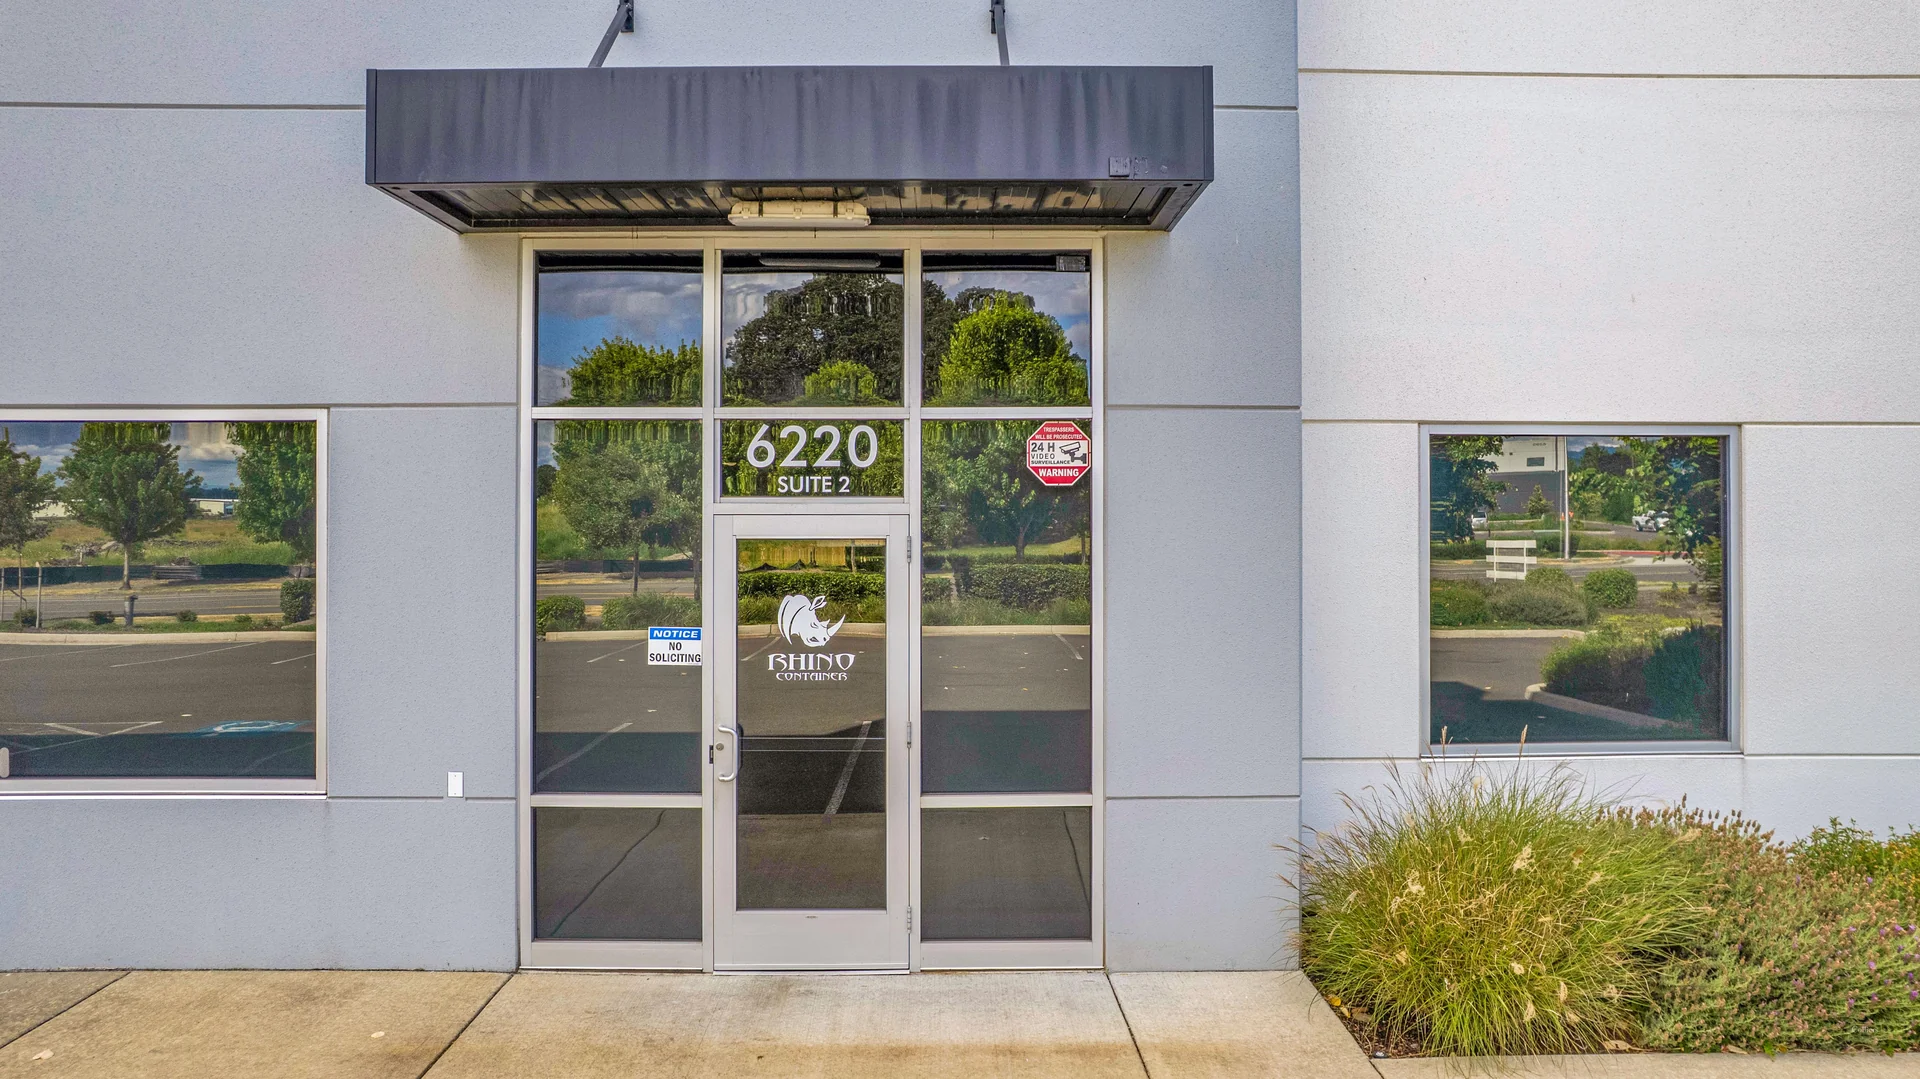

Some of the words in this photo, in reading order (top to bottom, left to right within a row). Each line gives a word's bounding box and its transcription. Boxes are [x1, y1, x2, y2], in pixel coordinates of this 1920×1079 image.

[747, 424, 878, 468] 6220
[1031, 442, 1044, 452] 24
[1048, 442, 1055, 452] H
[778, 476, 832, 493] SUITE
[838, 476, 850, 493] 2
[653, 630, 698, 638] NOTICE
[669, 641, 682, 651] NO
[649, 653, 701, 663] SOLICITING
[767, 653, 856, 671] RHINO
[776, 672, 848, 681] CONTAINER
